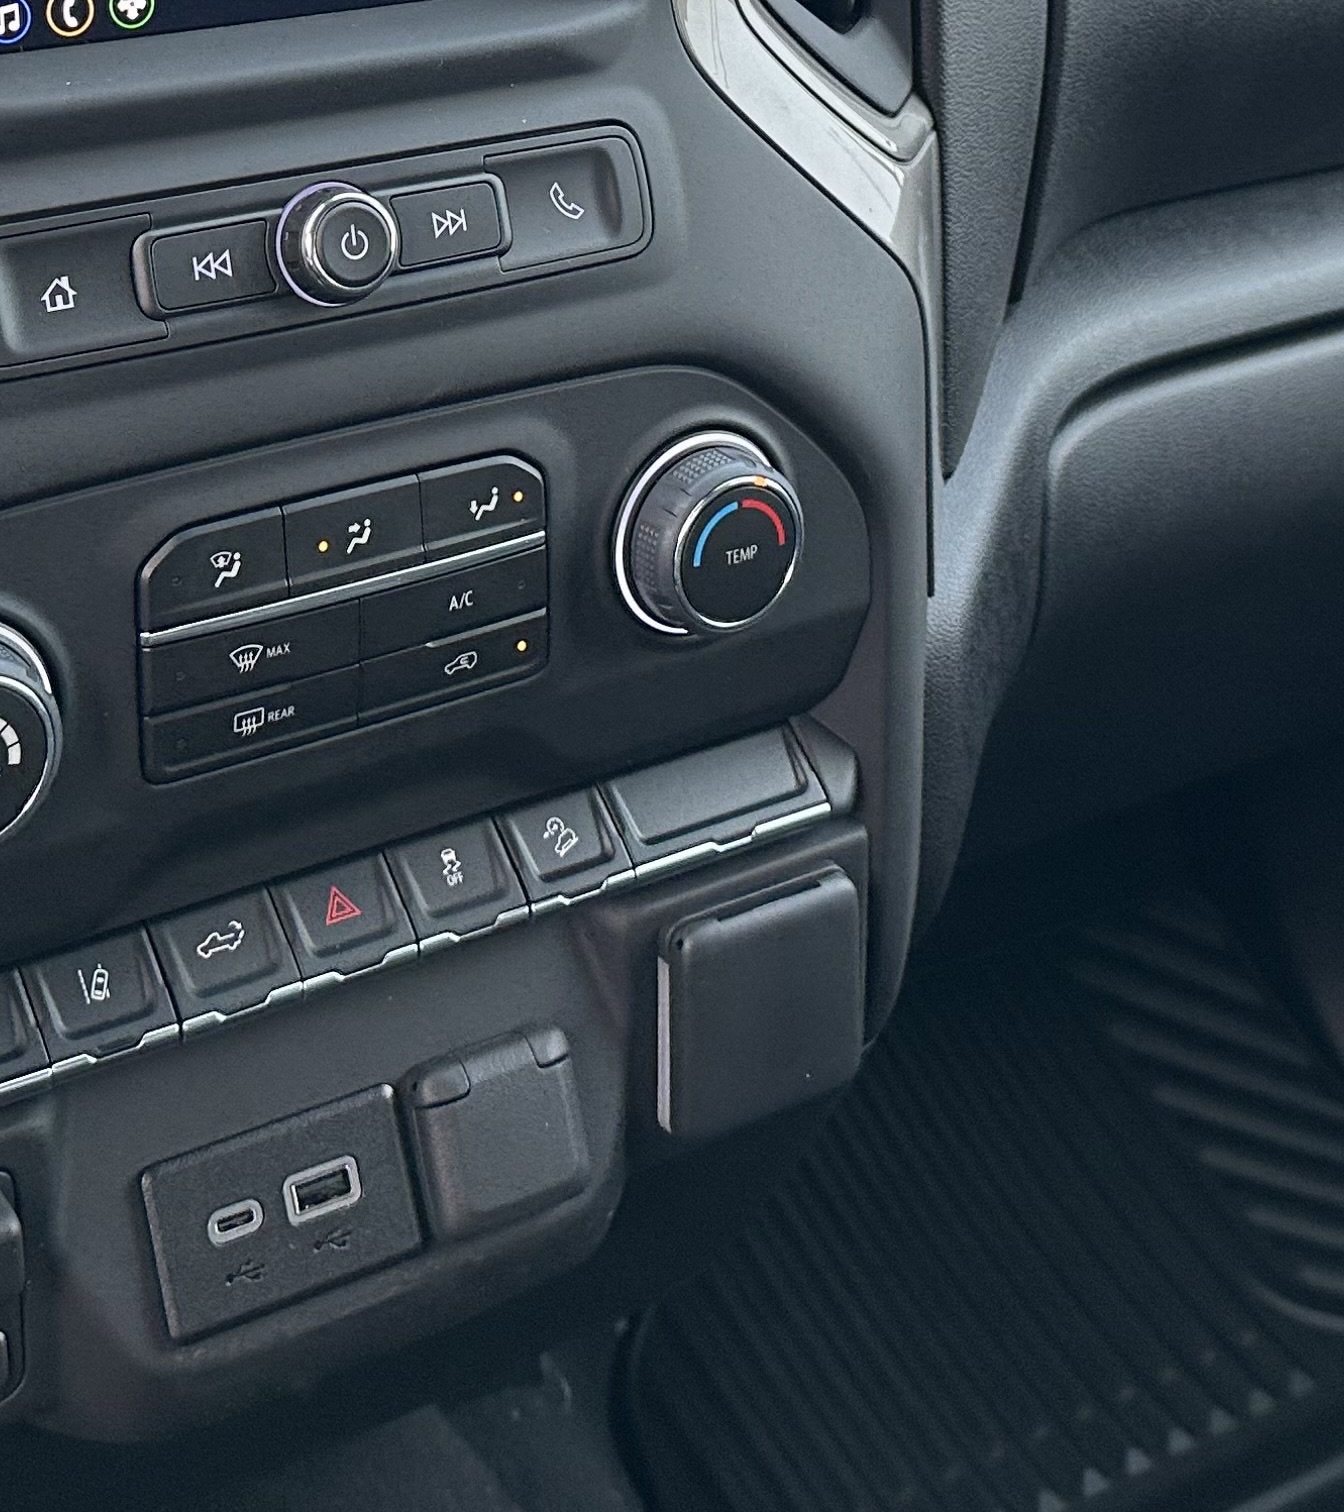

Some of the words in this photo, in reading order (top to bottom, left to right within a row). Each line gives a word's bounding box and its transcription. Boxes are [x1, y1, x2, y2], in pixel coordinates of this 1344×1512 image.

[725, 544, 758, 566] TEMP
[448, 589, 474, 612] A/C
[266, 641, 291, 658] MAX
[267, 705, 295, 722] REAR
[446, 871, 464, 886] OFF
